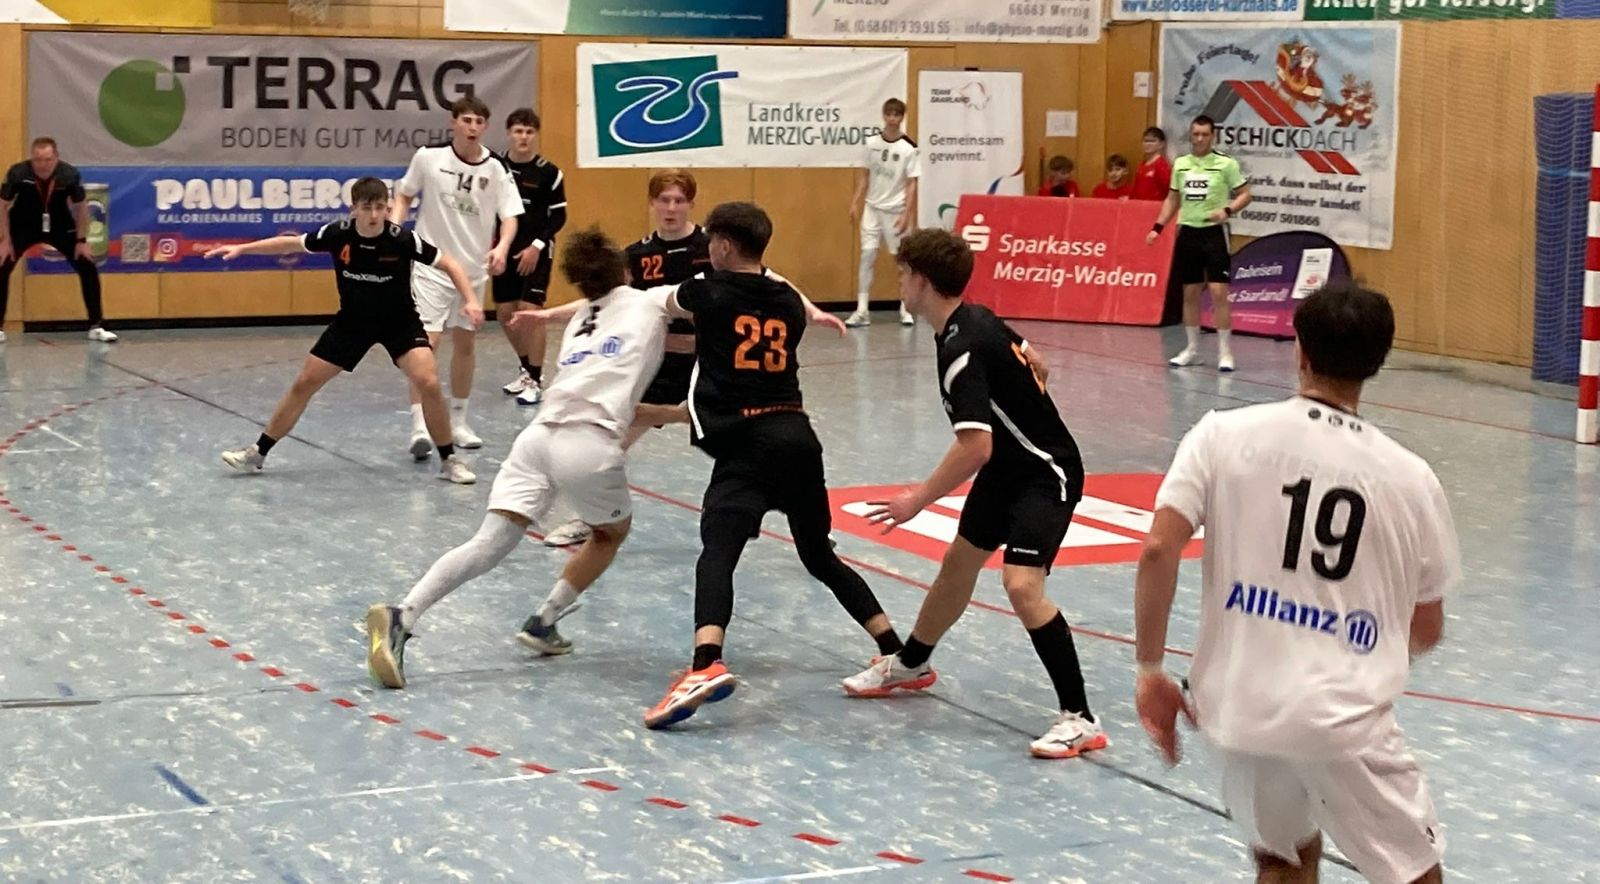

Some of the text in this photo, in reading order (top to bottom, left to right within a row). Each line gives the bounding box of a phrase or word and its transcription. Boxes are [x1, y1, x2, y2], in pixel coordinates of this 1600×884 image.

[1050, 4, 1089, 19] Merzig
[207, 56, 475, 111] TERRAG
[748, 102, 840, 122] Landkreis
[221, 128, 306, 149] BODEN
[315, 128, 366, 150] GUT
[747, 126, 881, 146] MERZIG-WADE
[929, 134, 1004, 147] Gemeinsam
[929, 151, 985, 164] gewinnt.
[457, 171, 474, 194] 14
[152, 178, 420, 211] PAULBER
[157, 213, 263, 224] KALORIENARMES
[998, 233, 1107, 257] Sparkasse
[641, 254, 665, 281] 22
[993, 261, 1157, 287] Merzig-Wadern
[734, 315, 788, 372] 23
[1281, 476, 1367, 581] 19
[1224, 580, 1340, 635] Allianz
